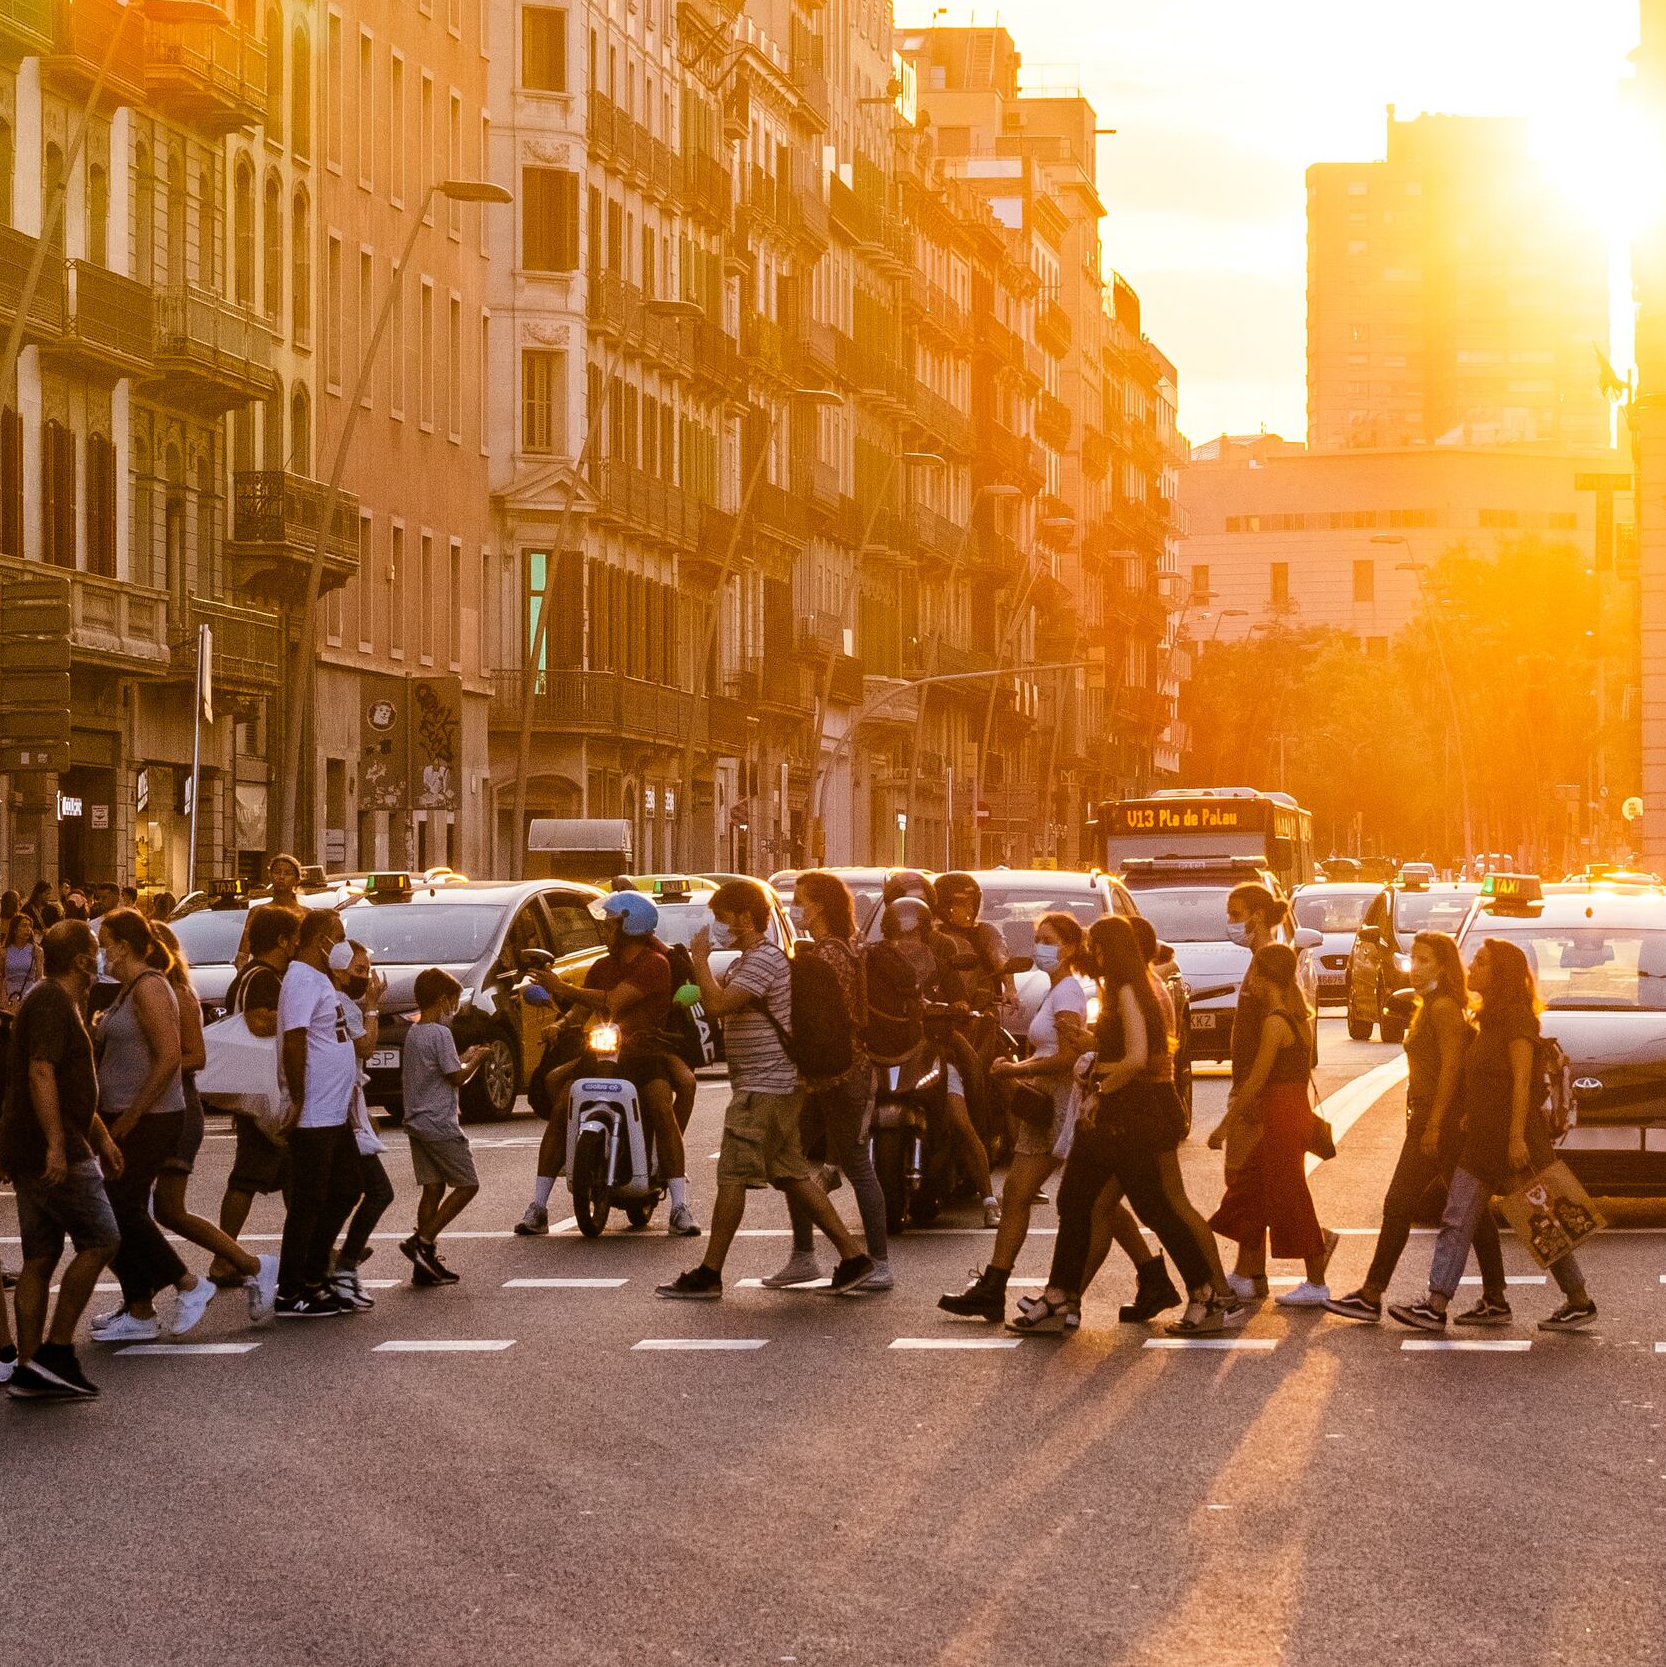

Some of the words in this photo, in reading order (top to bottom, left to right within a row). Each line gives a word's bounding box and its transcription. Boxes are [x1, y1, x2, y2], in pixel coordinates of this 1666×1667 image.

[1127, 810, 1155, 828] V13
[1159, 809, 1180, 827] Pla
[1184, 808, 1199, 826] de
[1202, 807, 1237, 826] Palau
[215, 882, 235, 893] TAXI
[236, 879, 242, 893] 1
[1496, 878, 1520, 893] TAXI
